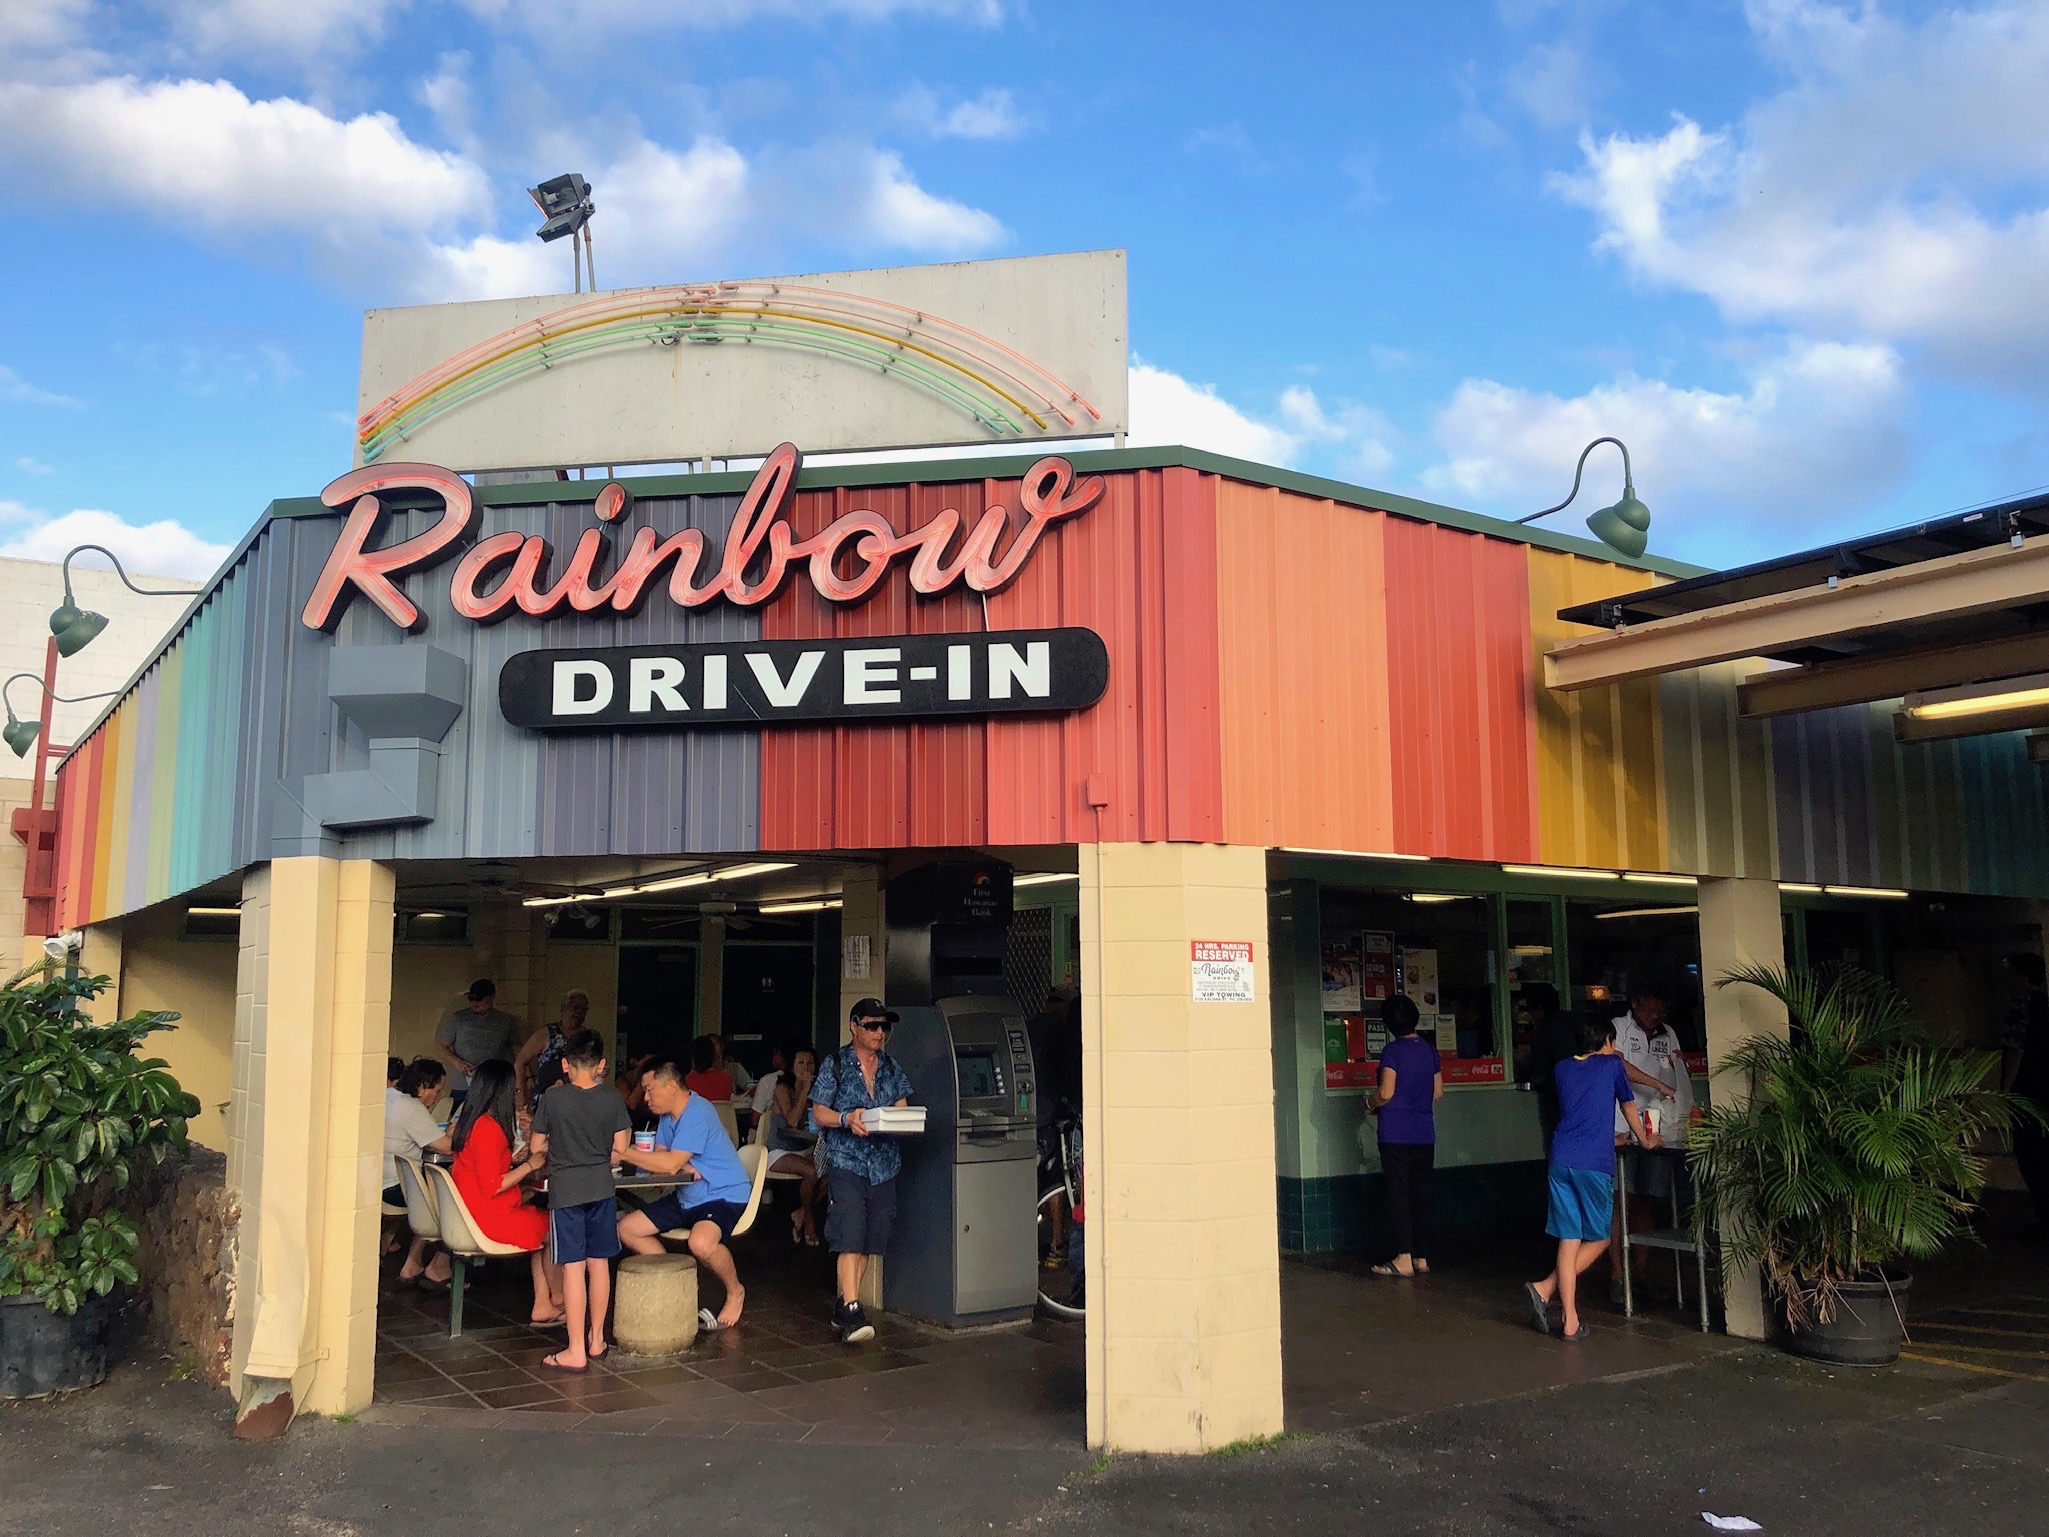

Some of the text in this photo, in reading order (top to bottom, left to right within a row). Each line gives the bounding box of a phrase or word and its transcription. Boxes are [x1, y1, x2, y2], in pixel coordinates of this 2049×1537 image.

[302, 442, 1105, 633] Rainbow
[551, 642, 1051, 716] DRIVE-IN
[1220, 943, 1249, 951] PARKING
[1195, 949, 1249, 961] RESERVED
[1367, 1024, 1386, 1032] PASS
